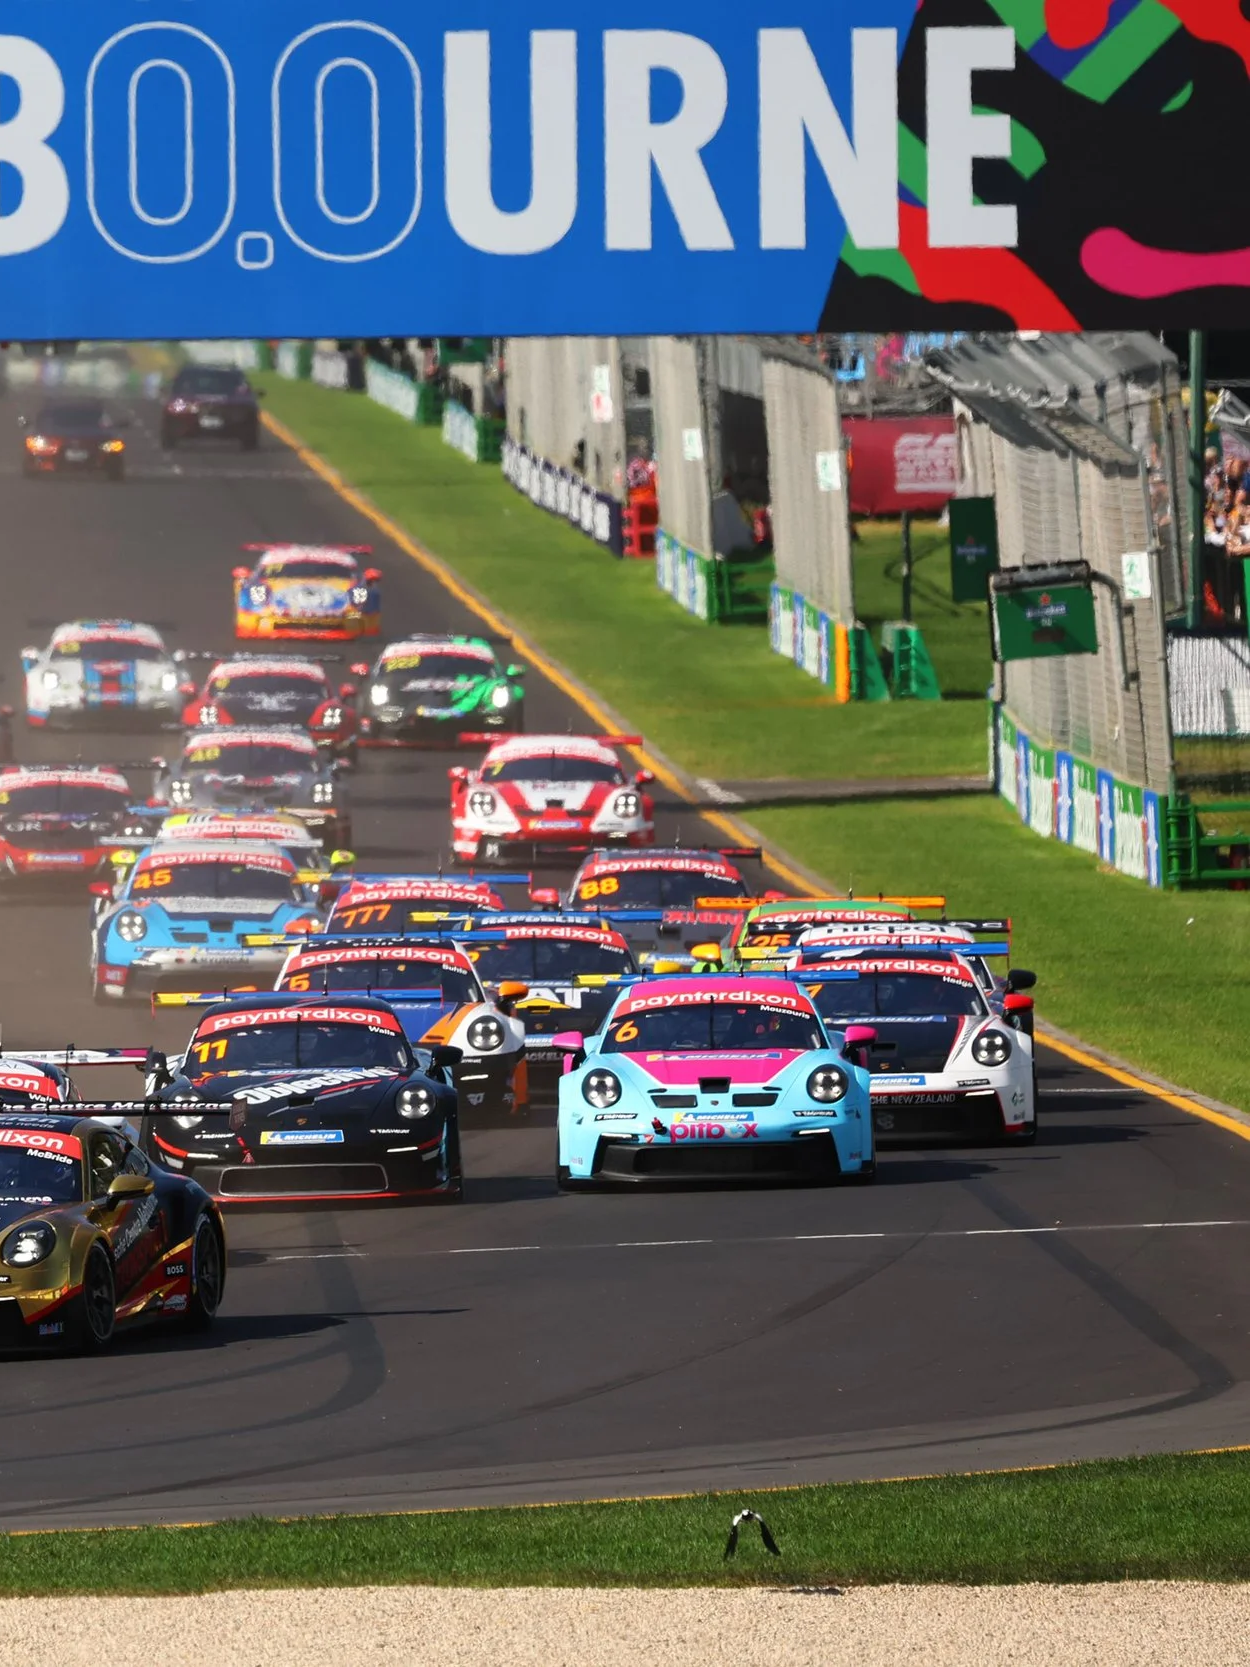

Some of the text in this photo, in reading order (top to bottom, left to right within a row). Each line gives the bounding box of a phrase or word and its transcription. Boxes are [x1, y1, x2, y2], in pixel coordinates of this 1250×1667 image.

[150, 852, 283, 869] paynterdixon
[594, 858, 726, 875] paynterdixon
[132, 868, 174, 890] 45
[579, 876, 620, 900] 88
[351, 888, 491, 904] paynterdixon
[341, 903, 393, 929] 777
[506, 926, 613, 943] nterdixon
[301, 947, 455, 968] paynterdixon
[630, 990, 798, 1011] paynterdixon
[214, 1008, 382, 1031] paynterdixon
[760, 1004, 810, 1019] Mouzouris
[614, 1020, 639, 1043] 6
[194, 1039, 228, 1064] 11
[284, 1133, 338, 1141] MICHELIN
[27, 1148, 74, 1165] McBride
[166, 1264, 184, 1275] BOSS
